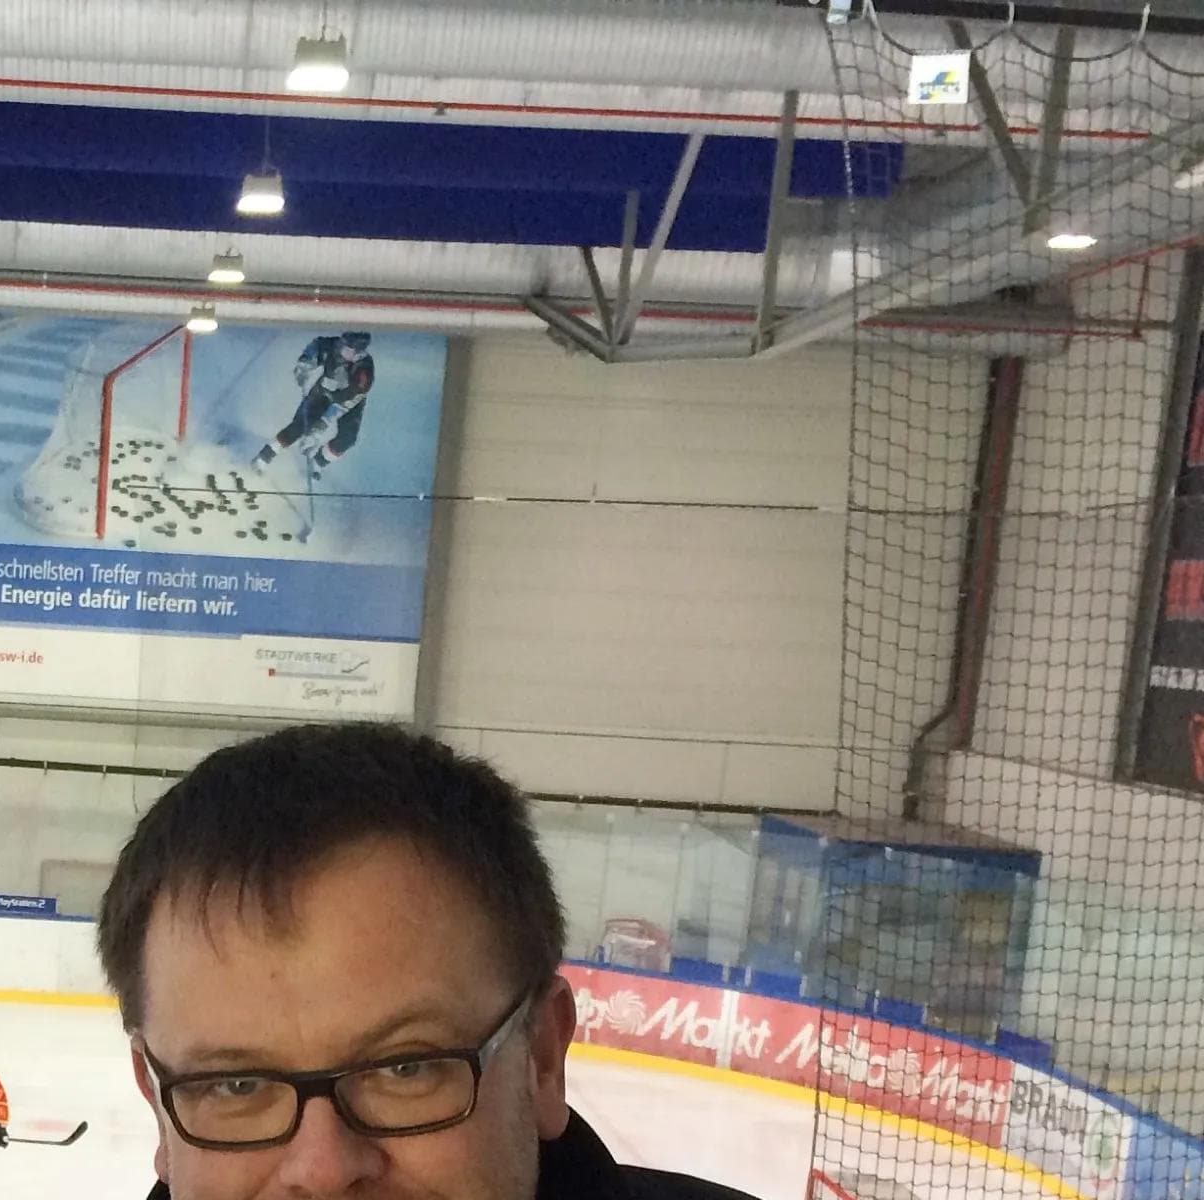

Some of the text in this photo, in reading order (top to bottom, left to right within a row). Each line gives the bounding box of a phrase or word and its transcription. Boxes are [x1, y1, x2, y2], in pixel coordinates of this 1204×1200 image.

[90, 563, 142, 585] Treffer
[147, 567, 197, 588] macht
[202, 574, 238, 591] man
[244, 571, 278, 593] hier.
[1, 584, 73, 611] Energie
[79, 587, 130, 610] dafür
[136, 590, 197, 614] liefern
[203, 595, 239, 616] wir.
[255, 648, 337, 663] STADTWERKE
